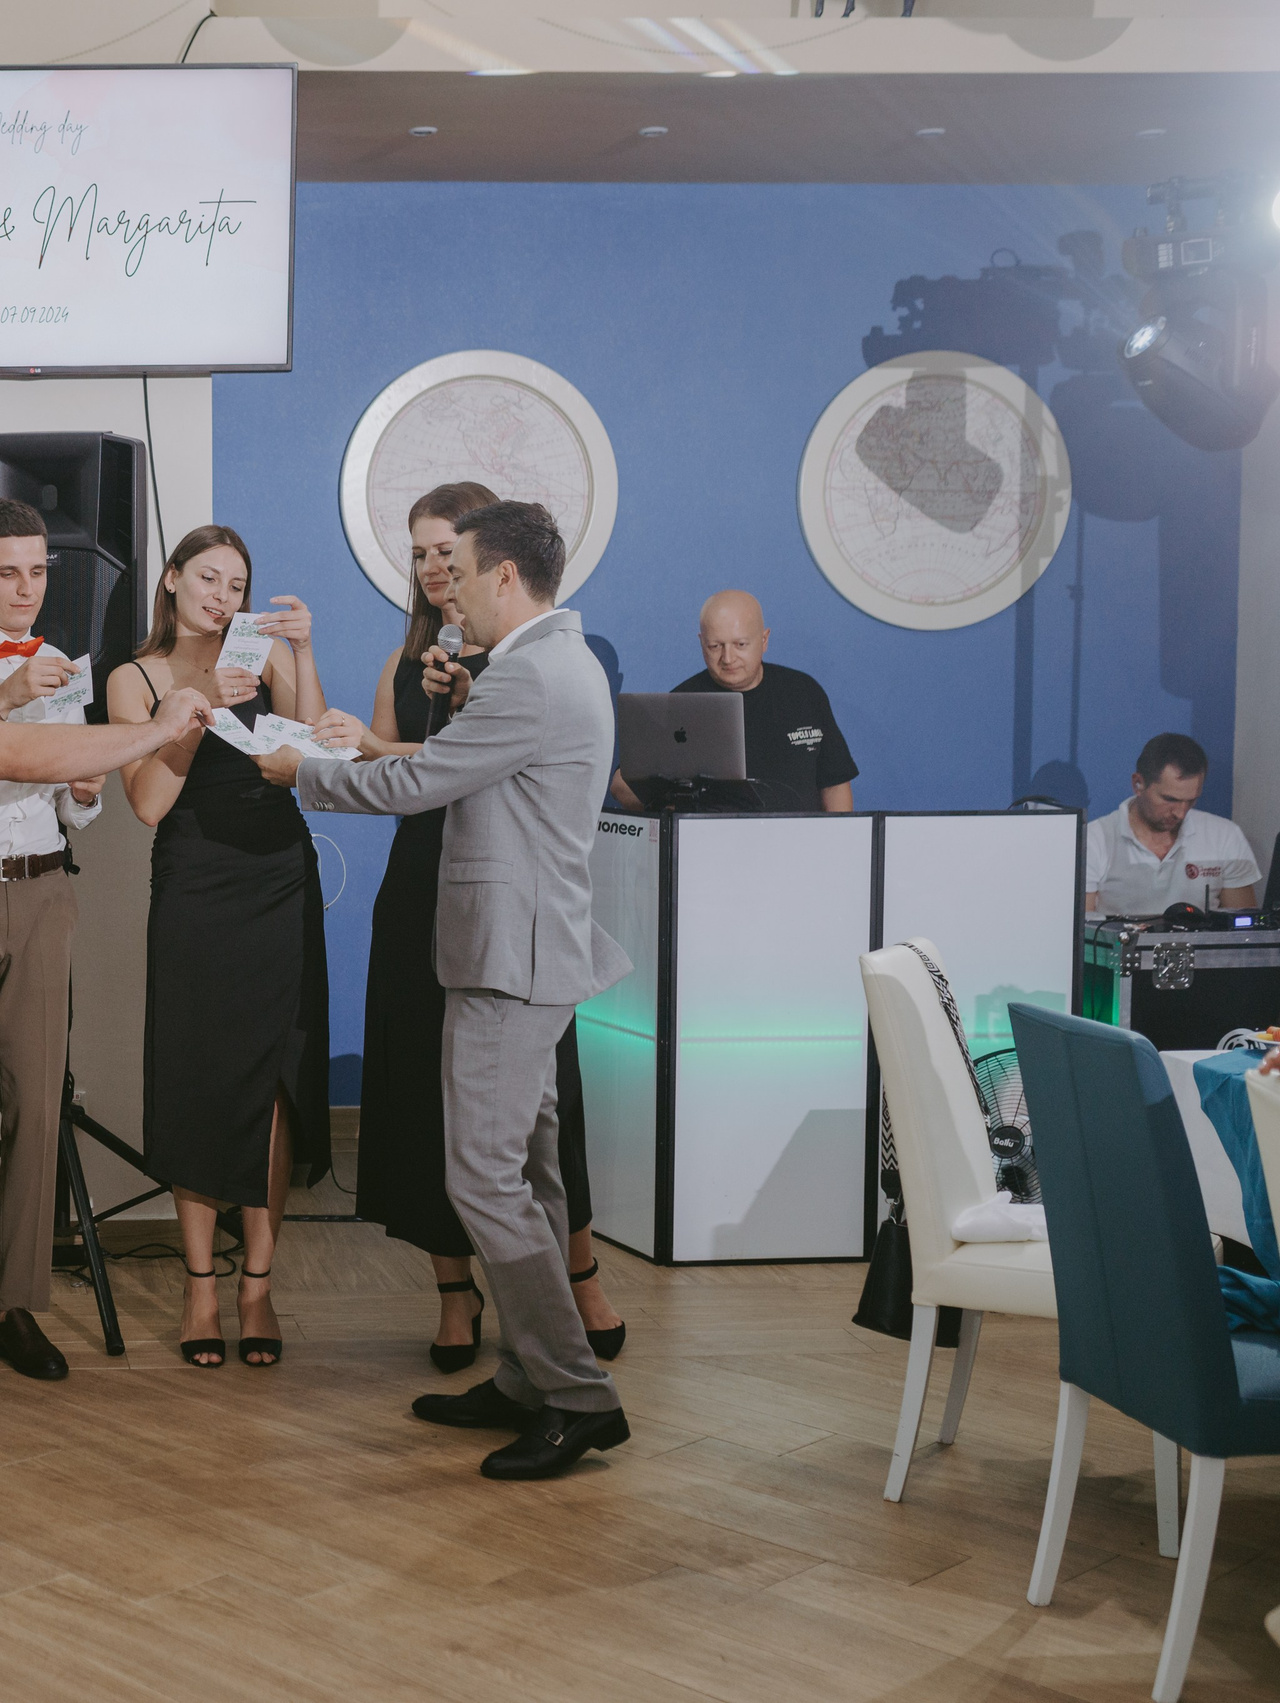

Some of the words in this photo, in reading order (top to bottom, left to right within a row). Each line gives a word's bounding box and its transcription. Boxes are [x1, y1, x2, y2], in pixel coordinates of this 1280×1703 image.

[57, 110, 89, 155] day
[32, 183, 258, 278] Margarita
[0, 305, 70, 324] 07.09.2024
[597, 820, 644, 837] ioneer
[993, 1136, 1014, 1148] Ballu
